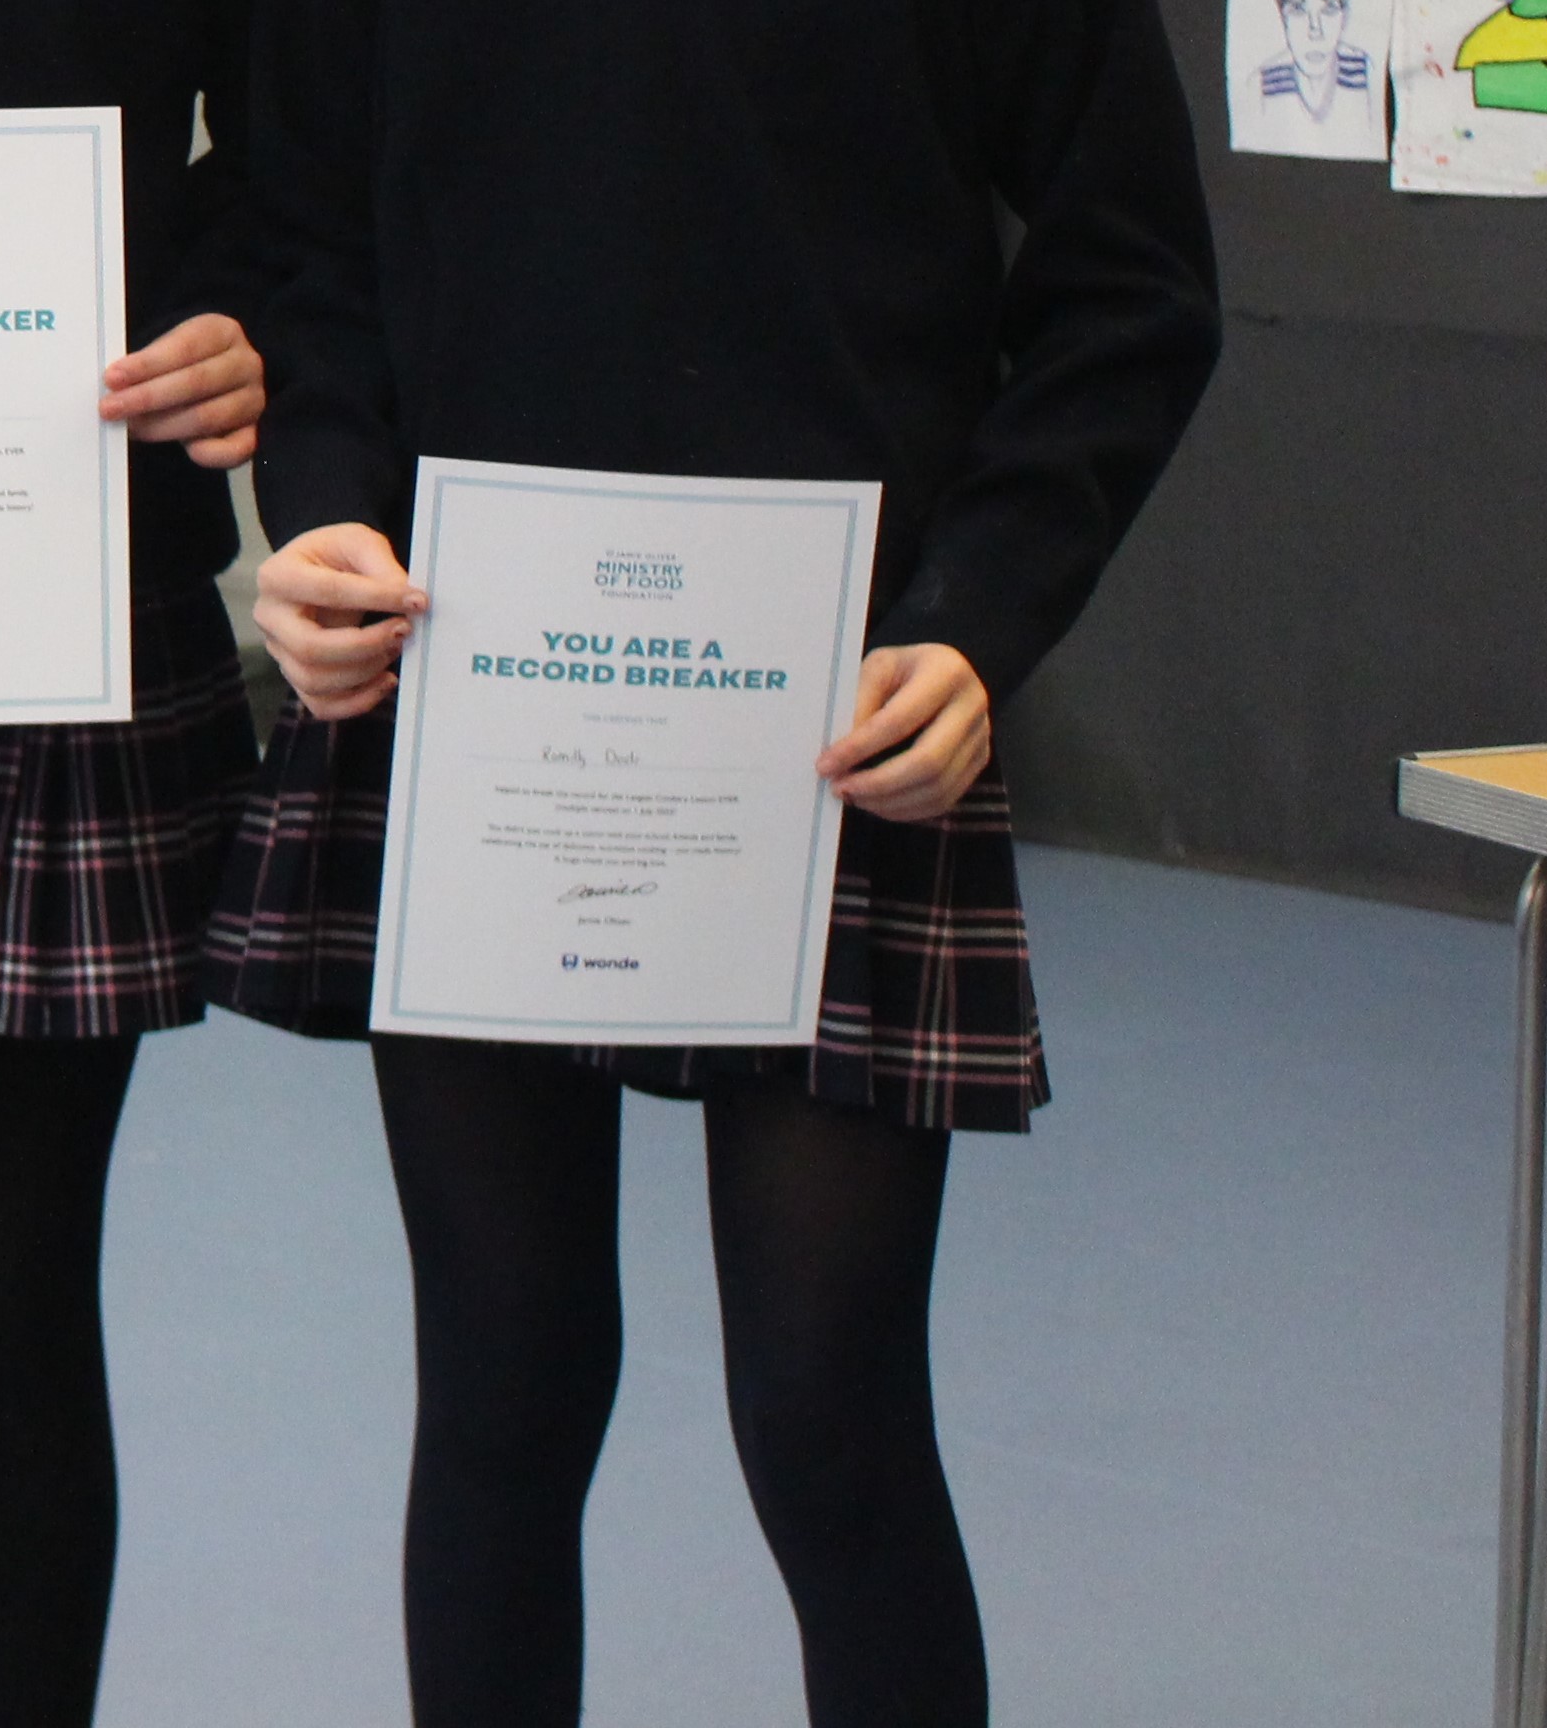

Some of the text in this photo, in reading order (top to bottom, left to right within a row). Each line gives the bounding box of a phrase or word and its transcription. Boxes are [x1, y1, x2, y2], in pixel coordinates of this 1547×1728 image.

[596, 561, 684, 576] MINISTRY
[594, 574, 684, 590] OF FOOD
[543, 632, 723, 660] YOU ARE A
[472, 654, 788, 690] RECORD BREAKER
[583, 957, 640, 970] wonde
